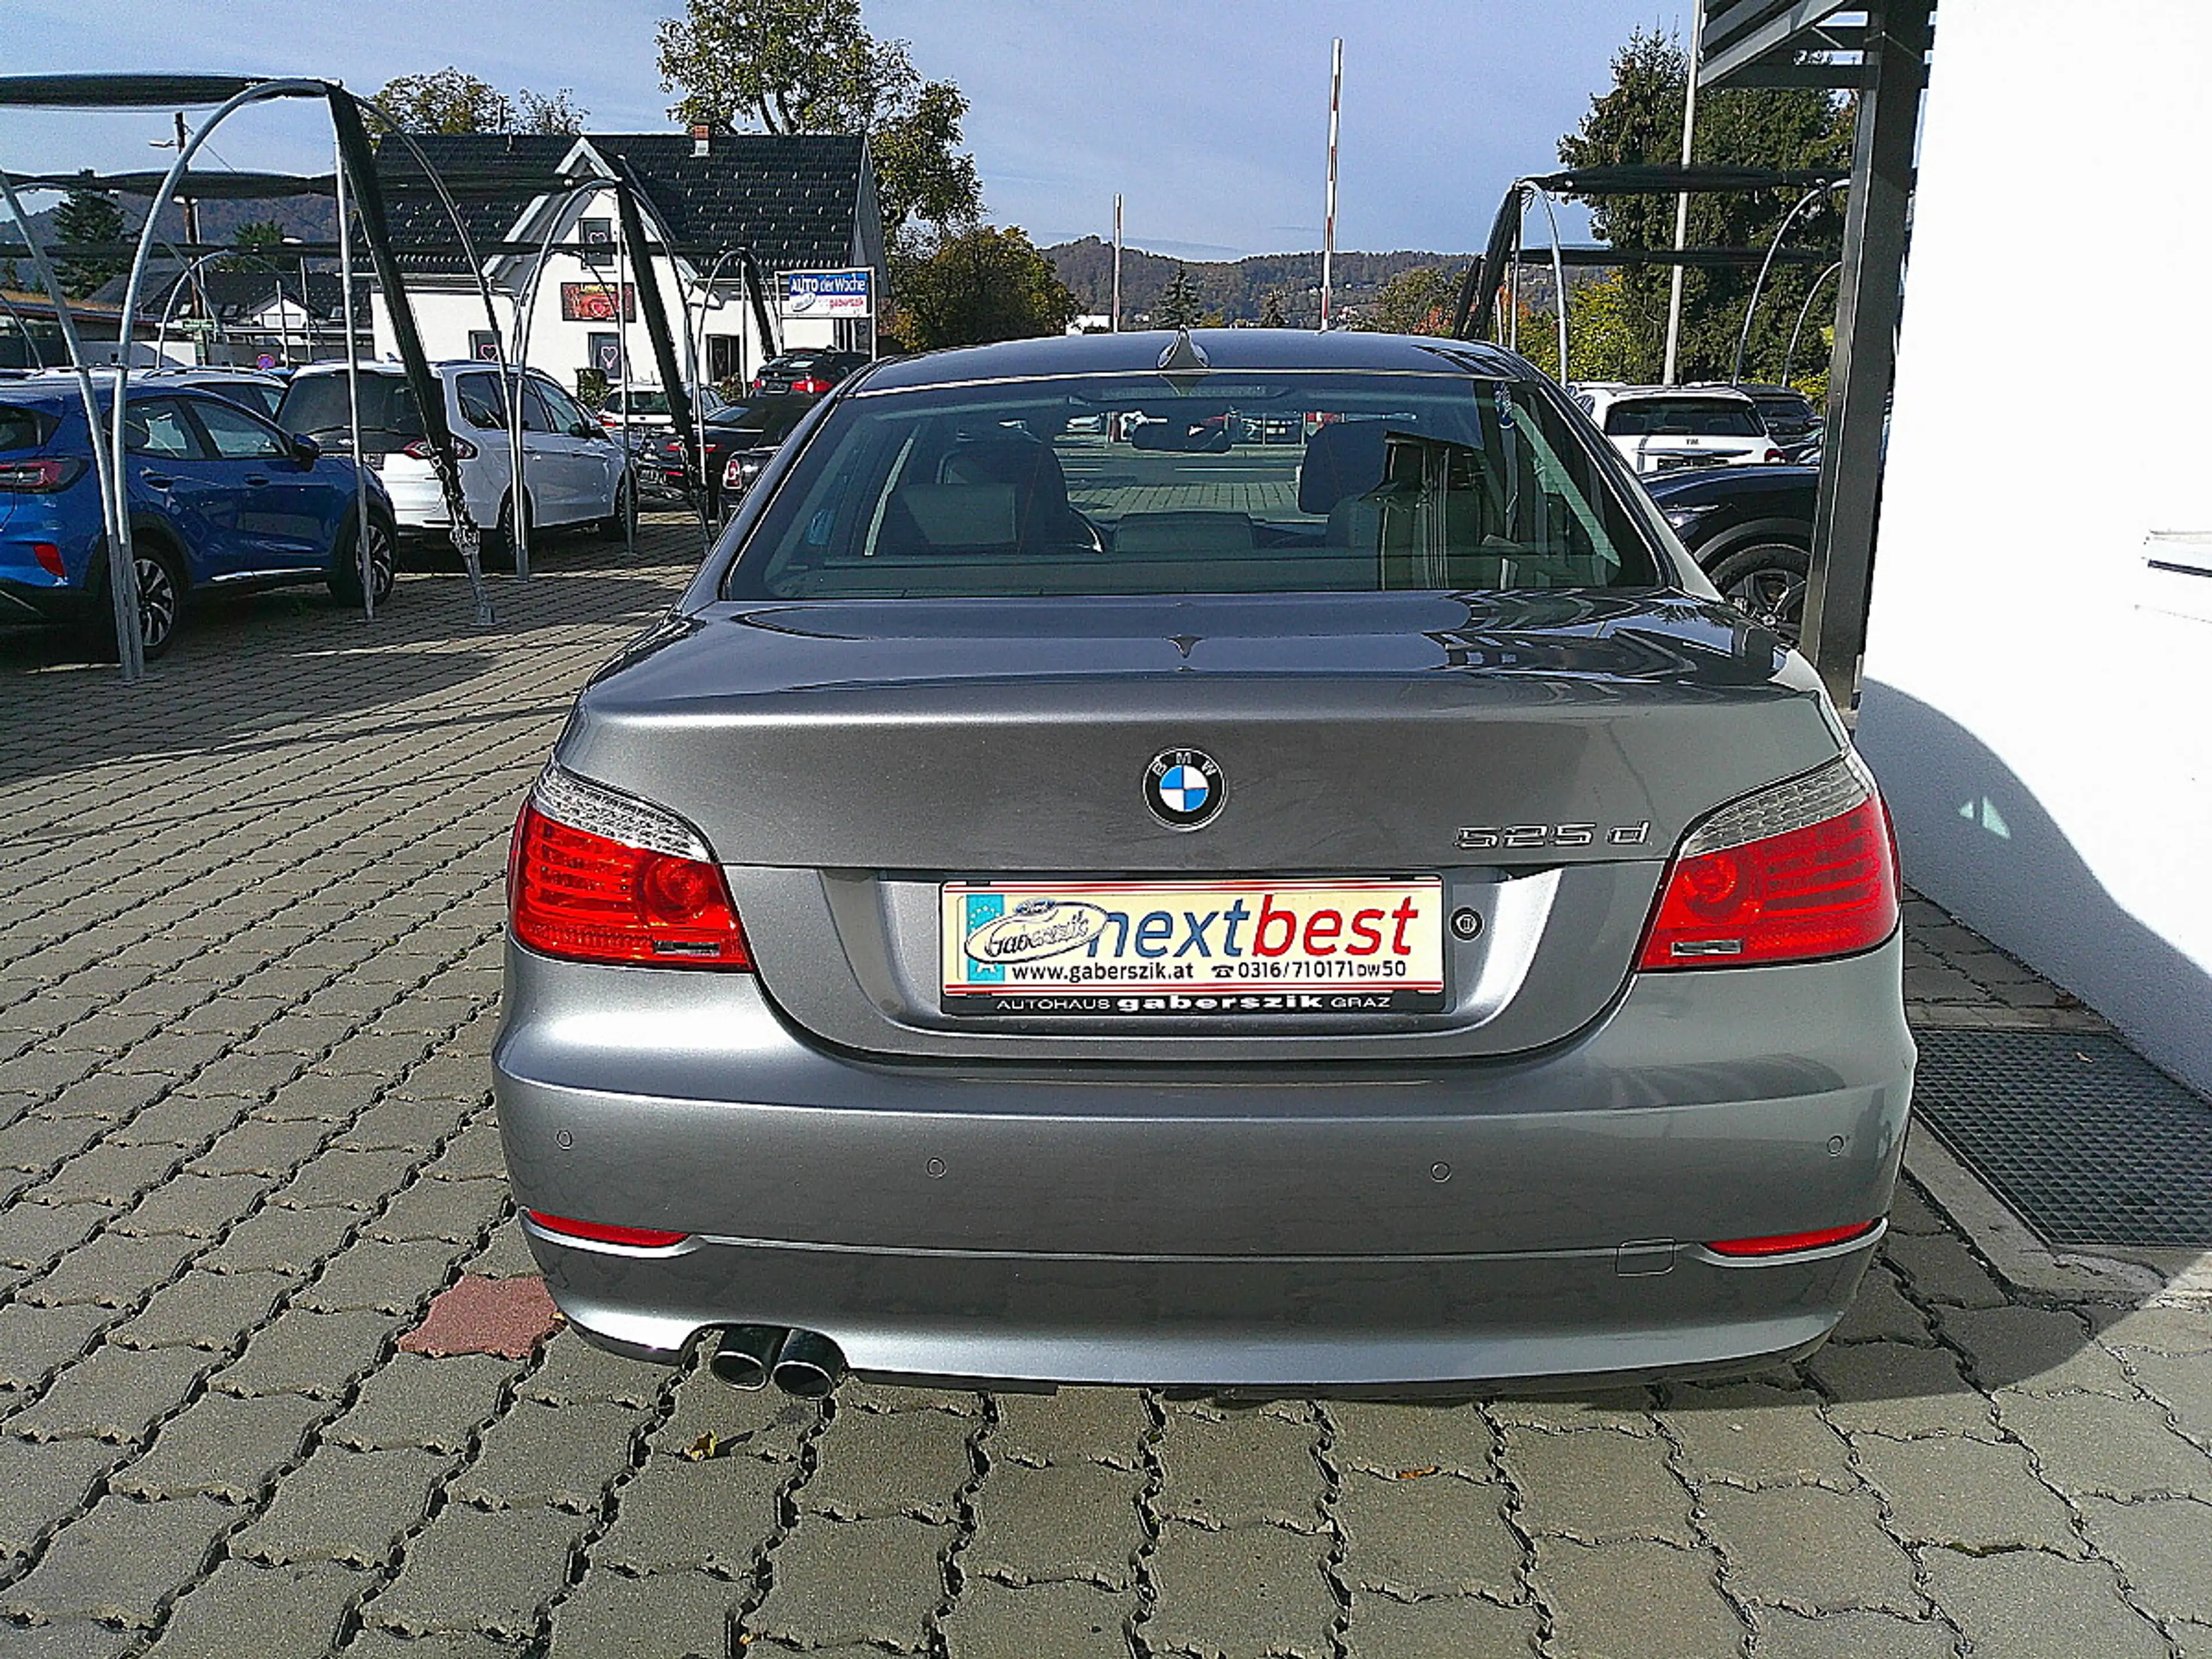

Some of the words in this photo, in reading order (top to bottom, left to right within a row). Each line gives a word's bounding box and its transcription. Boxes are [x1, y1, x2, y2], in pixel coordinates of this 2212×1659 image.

[790, 277, 819, 293] AUTO
[835, 273, 866, 292] Woche
[1152, 752, 1217, 777] BMW
[1012, 962, 1194, 983] www.gaberszik.at
[996, 998, 1111, 1010] AUTOHAUS
[1116, 995, 1323, 1012] gaberszik
[1330, 997, 1391, 1009] GRAZ
